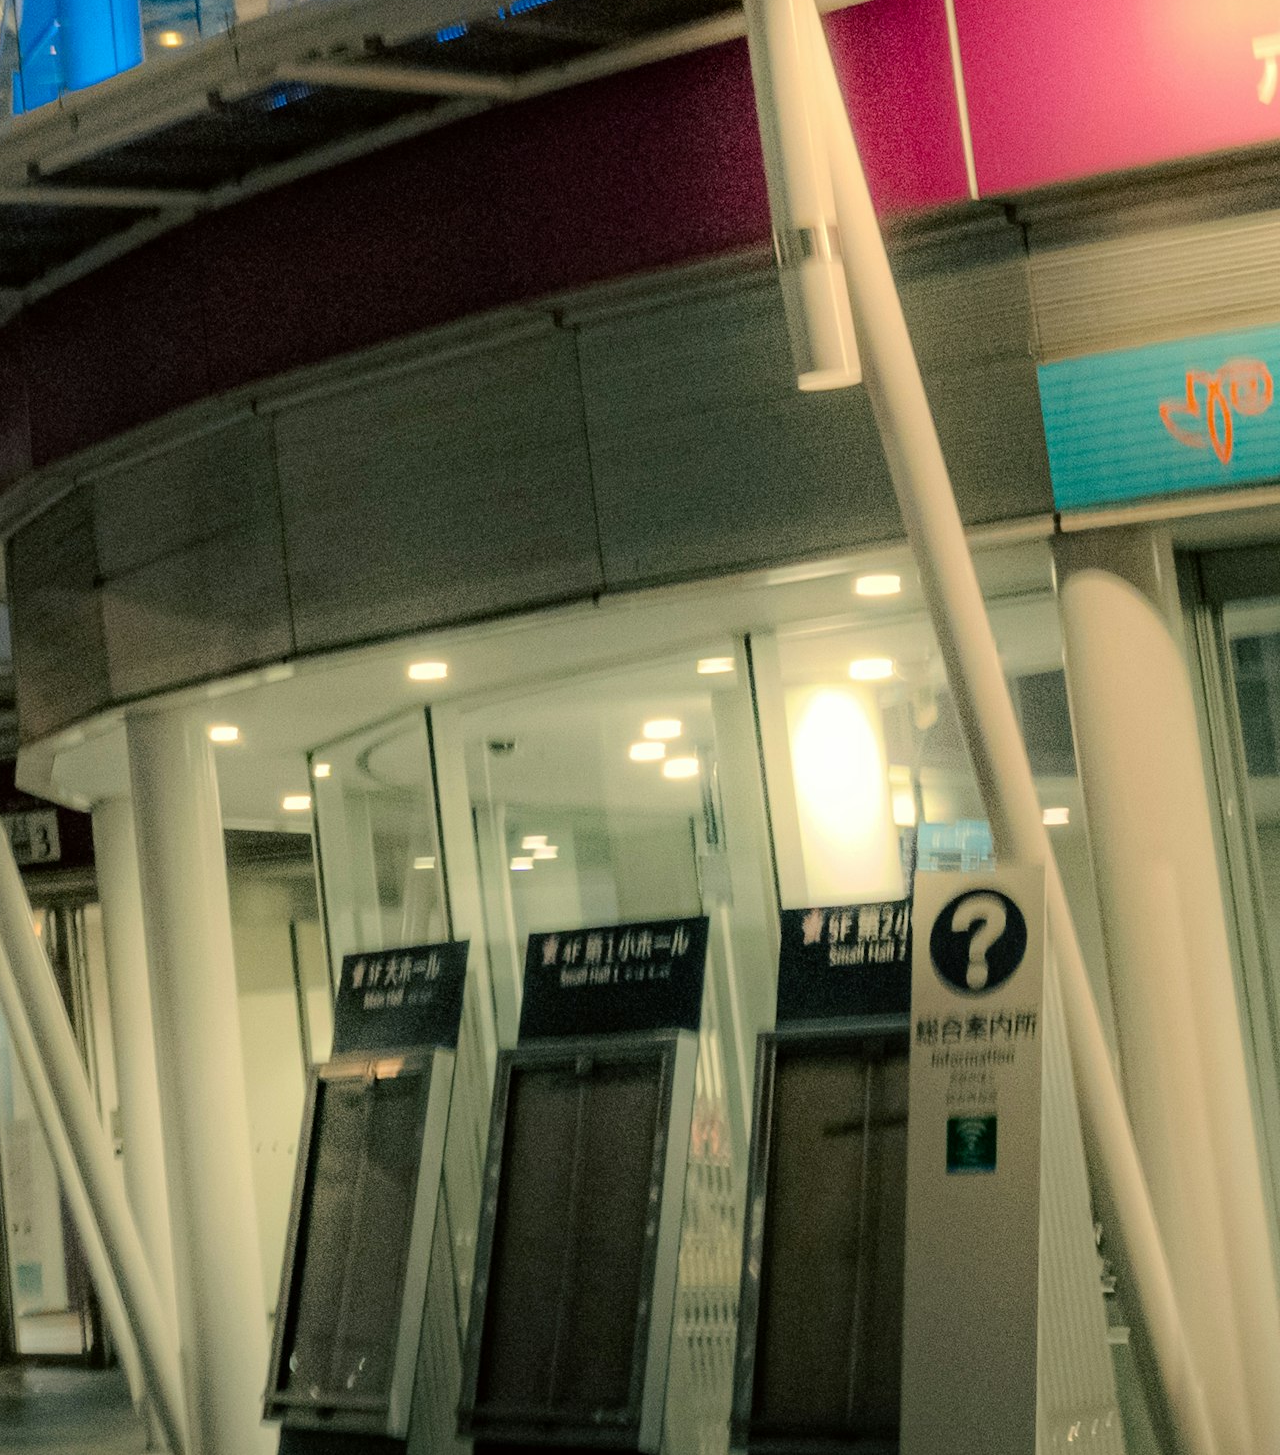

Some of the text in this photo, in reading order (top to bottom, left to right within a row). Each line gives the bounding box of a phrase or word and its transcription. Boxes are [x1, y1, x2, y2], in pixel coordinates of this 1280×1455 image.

[867, 940, 896, 965] Hall
[915, 1010, 1038, 1046] 総合案内所
[930, 1047, 1016, 1069] Information
